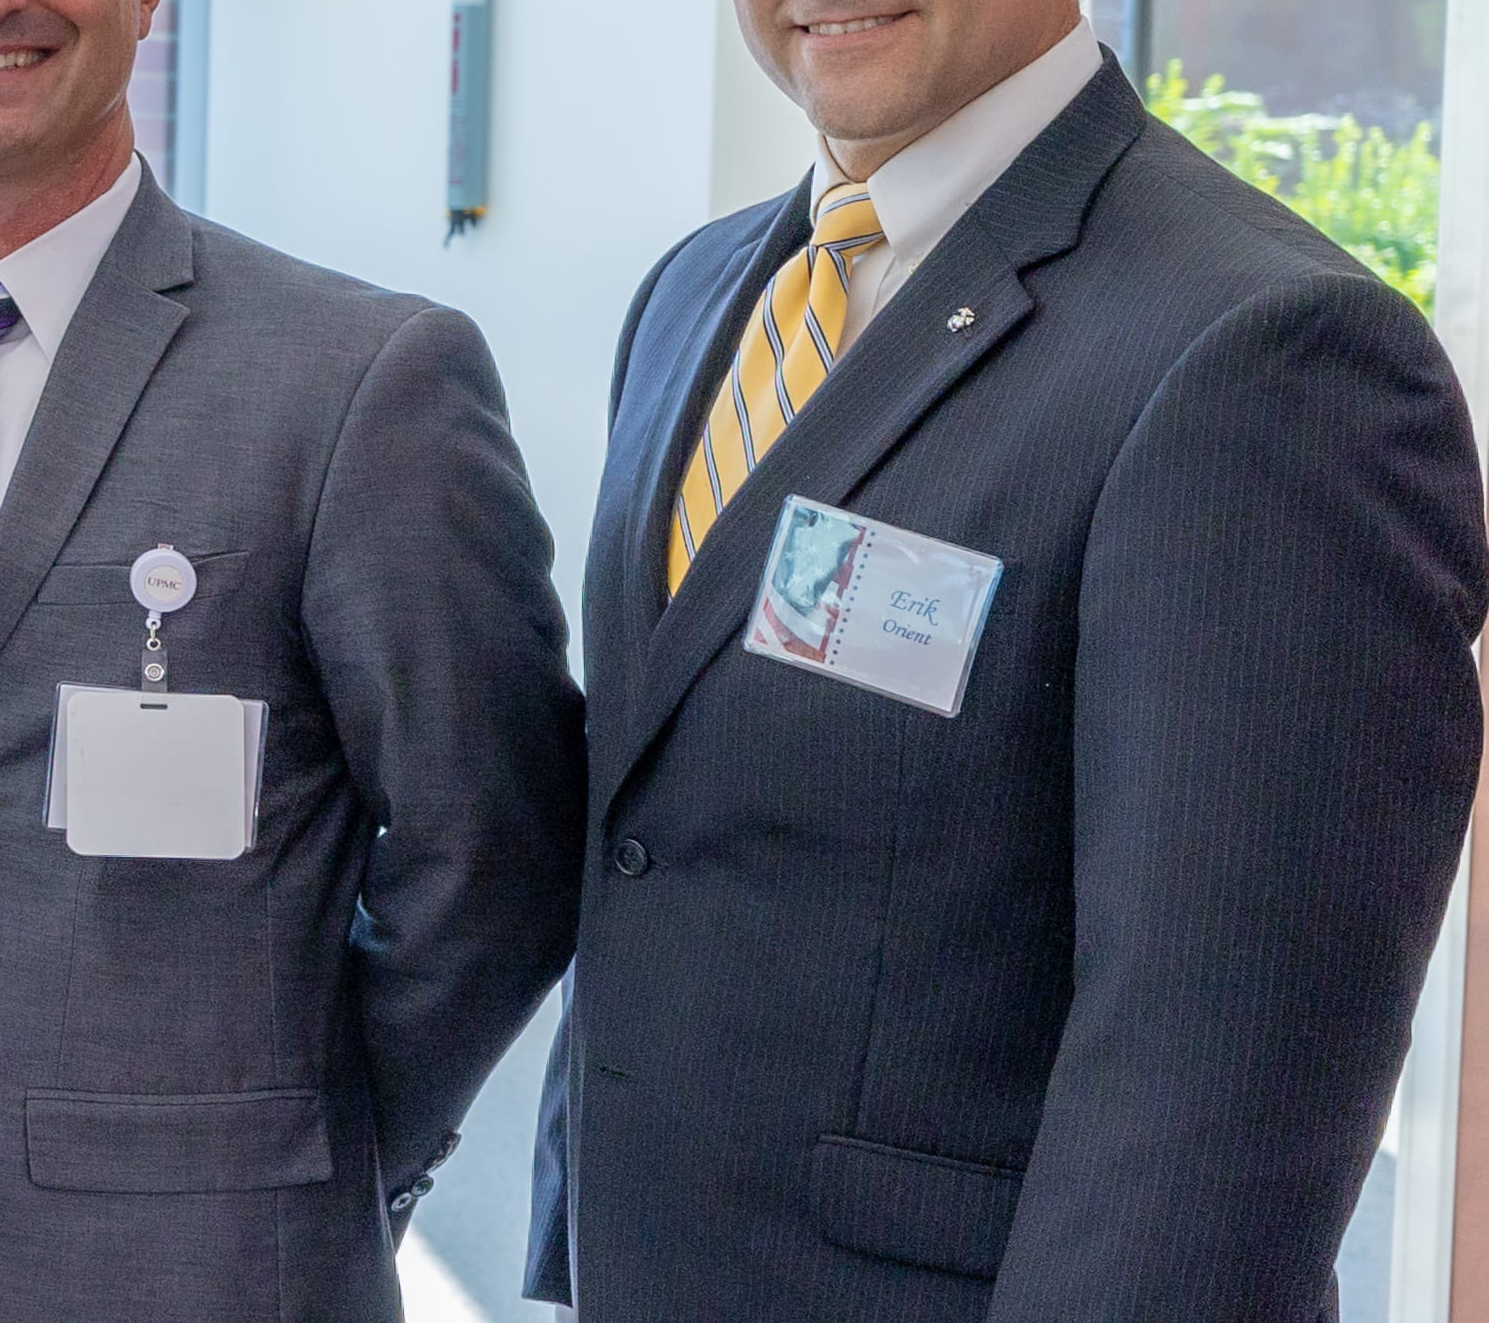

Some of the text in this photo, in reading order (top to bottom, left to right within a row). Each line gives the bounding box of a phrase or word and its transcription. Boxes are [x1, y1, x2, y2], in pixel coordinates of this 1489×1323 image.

[147, 576, 182, 591] UPMC
[889, 589, 942, 626] Erik
[882, 619, 932, 645] Orient
